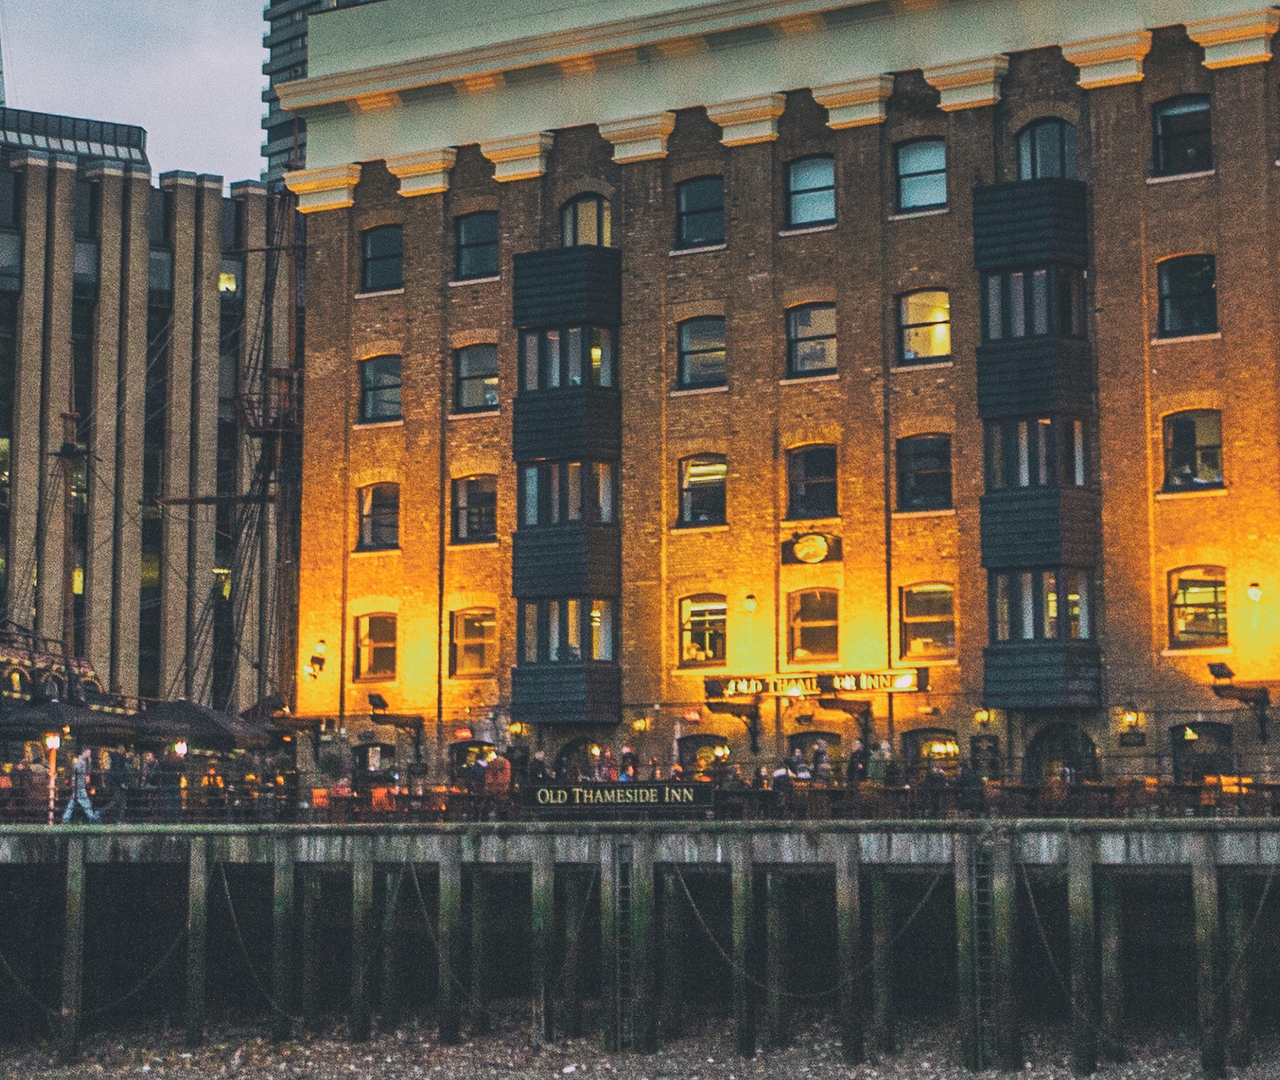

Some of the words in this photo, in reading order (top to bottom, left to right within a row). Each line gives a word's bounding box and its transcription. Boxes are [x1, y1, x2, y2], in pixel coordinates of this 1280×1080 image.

[859, 673, 893, 692] INN
[537, 788, 568, 804] OLD
[572, 787, 658, 803] THAMESIDE
[664, 786, 695, 802] INN
